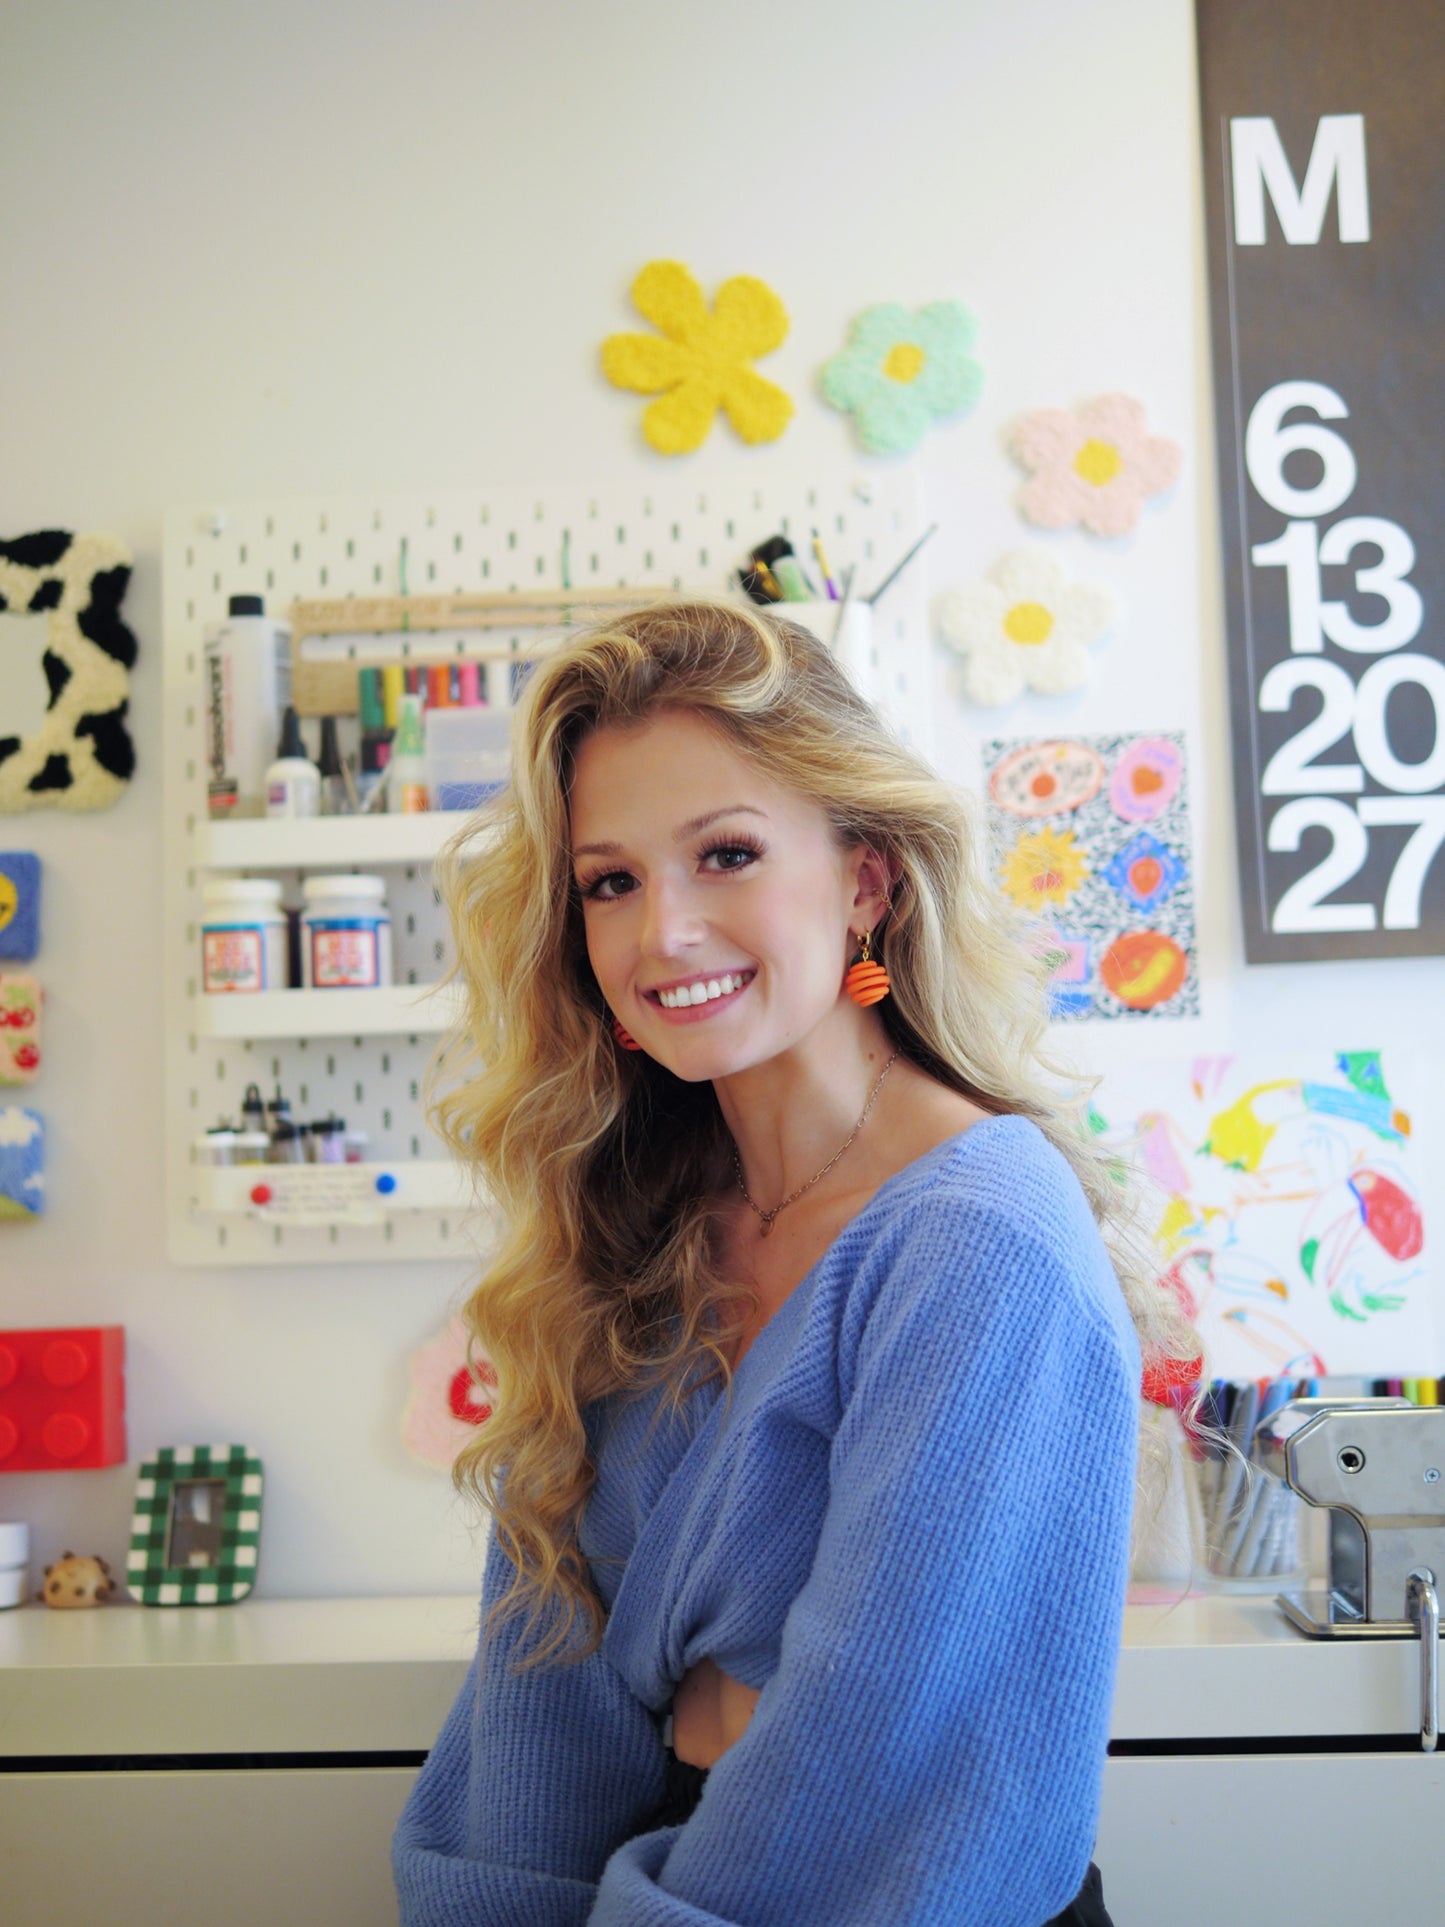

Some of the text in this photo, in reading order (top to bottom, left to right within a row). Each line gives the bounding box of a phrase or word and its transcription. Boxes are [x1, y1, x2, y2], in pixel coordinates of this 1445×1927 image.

[1230, 114, 1370, 246] M
[1245, 381, 1357, 517] 6
[1251, 516, 1424, 654] 13
[1258, 653, 1445, 796] 20
[1267, 795, 1445, 934] 27
